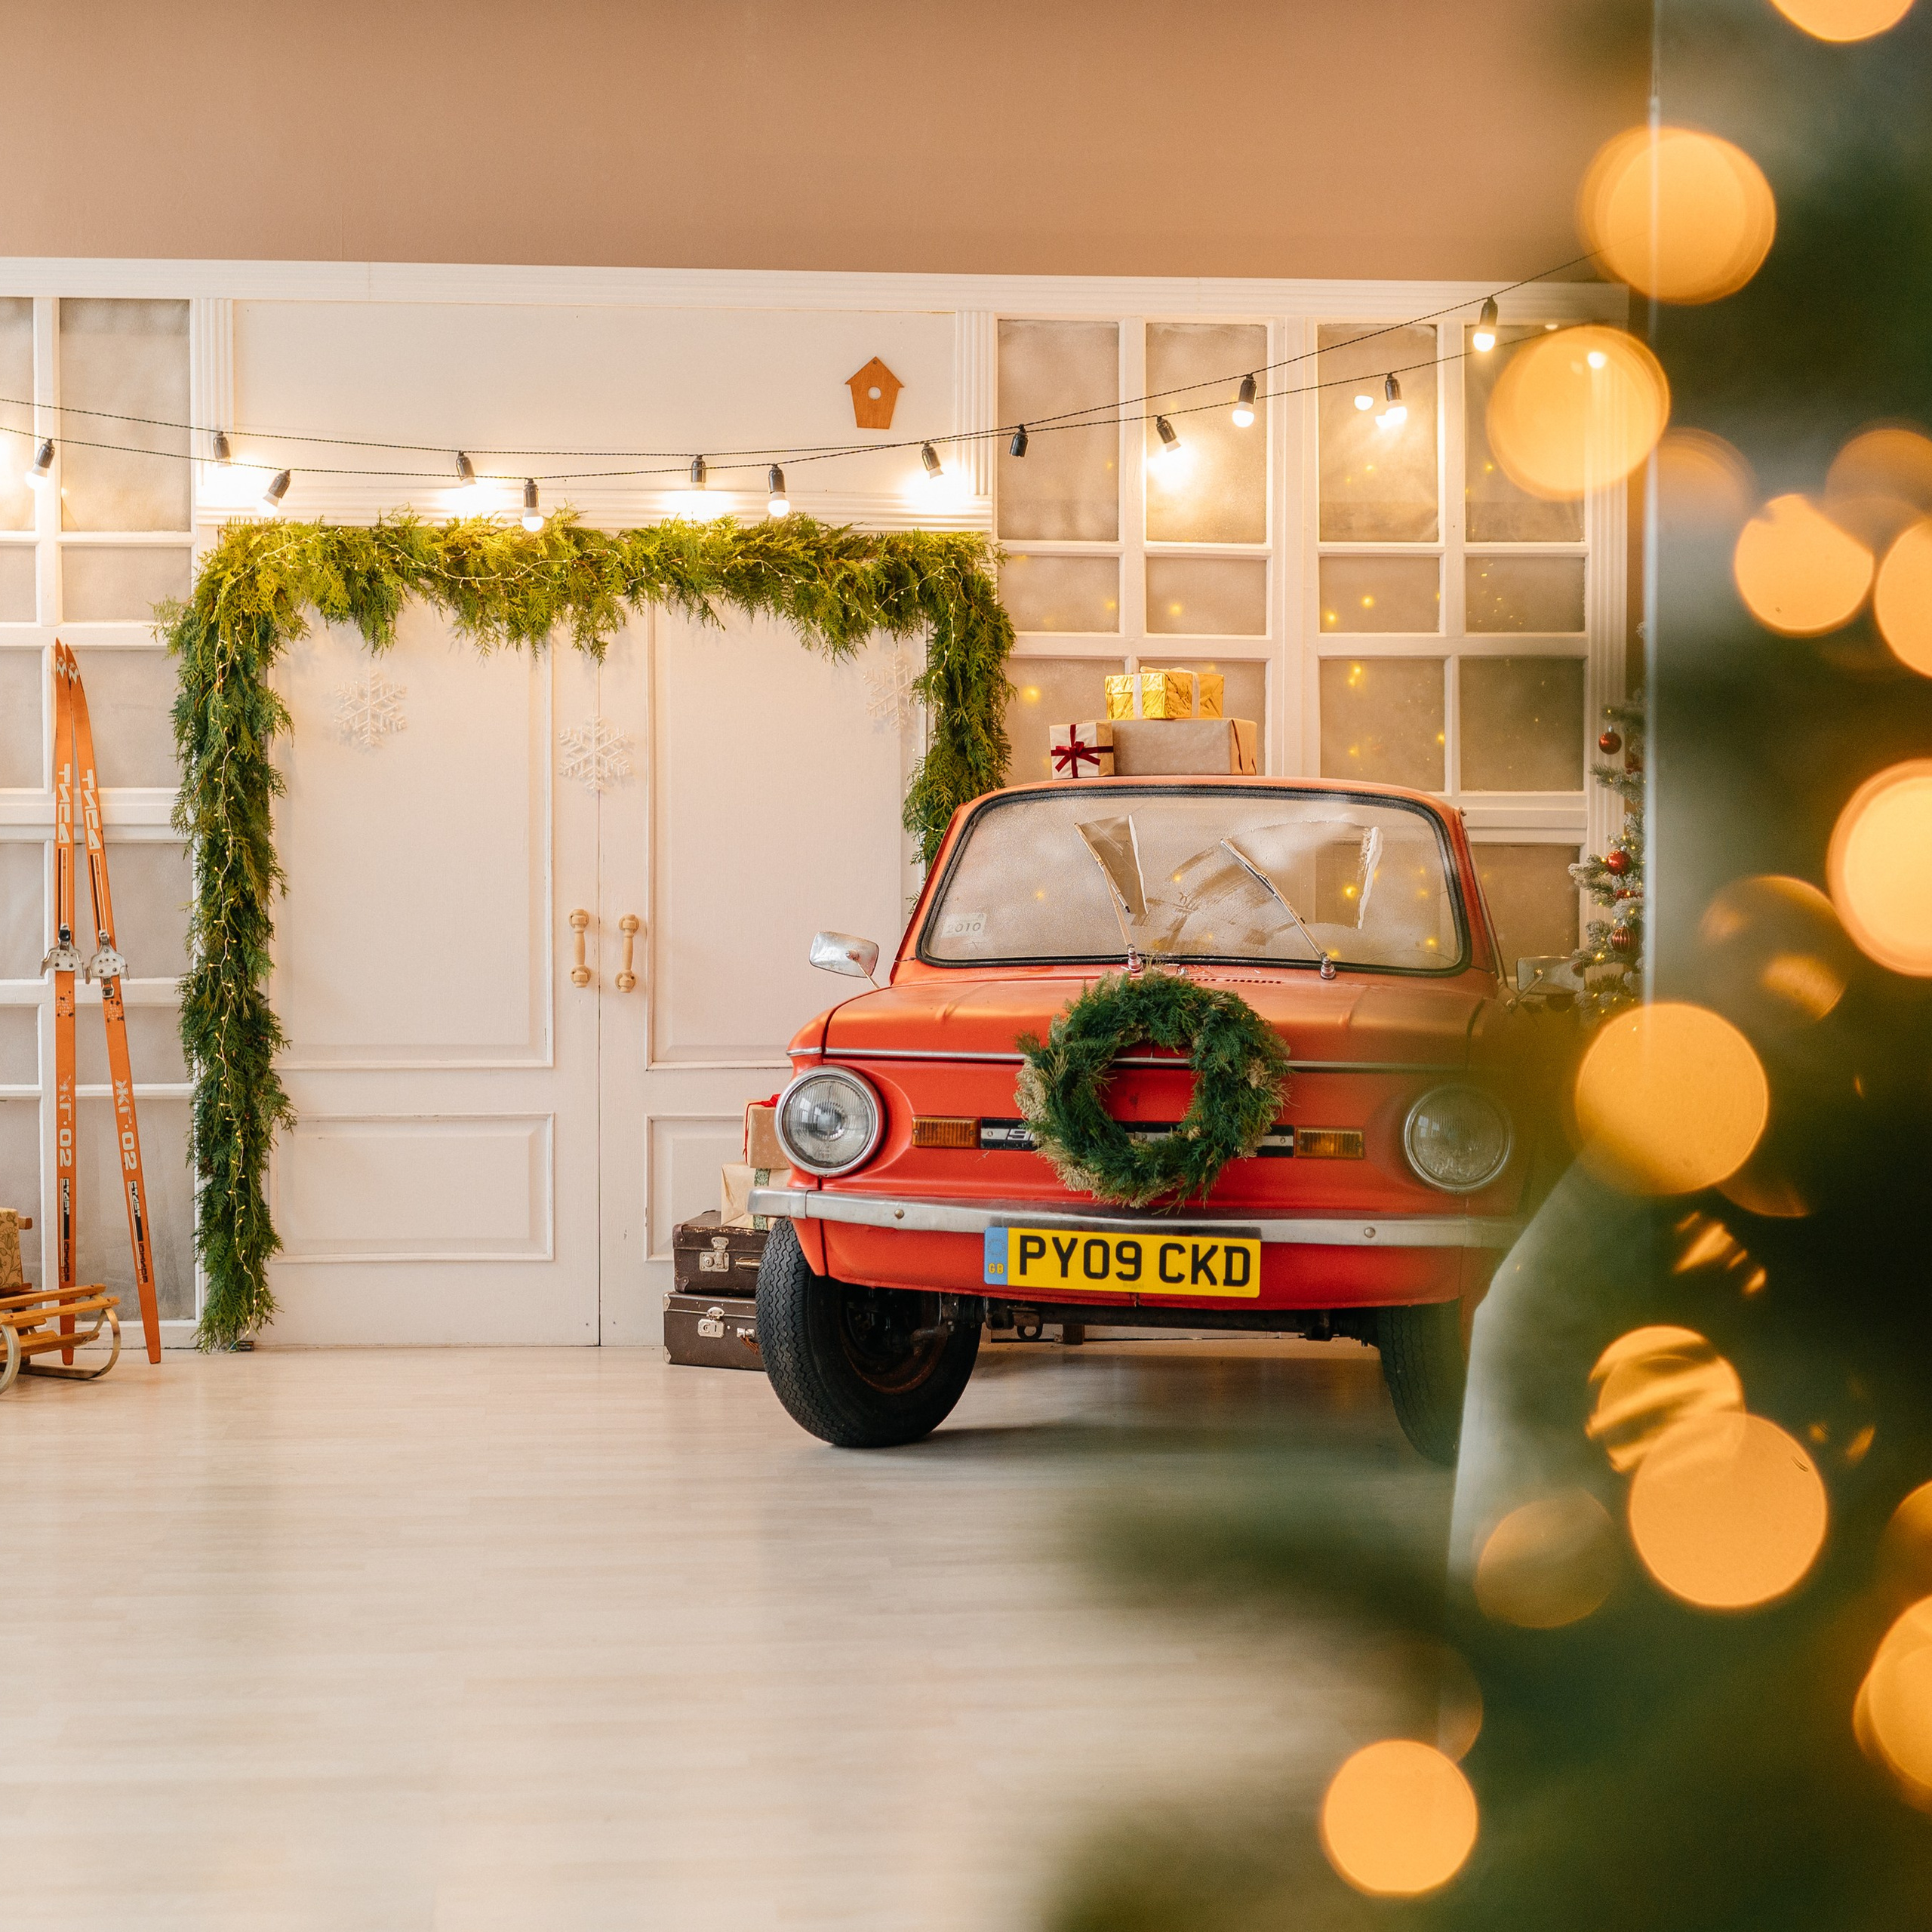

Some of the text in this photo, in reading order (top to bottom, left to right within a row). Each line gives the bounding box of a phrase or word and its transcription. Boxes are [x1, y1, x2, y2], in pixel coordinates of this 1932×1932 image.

[58, 763, 71, 844] ТИСА
[82, 769, 101, 850] ТИСА
[988, 1263, 1004, 1275] GB
[1019, 1235, 1251, 1287] PY09 CKD
